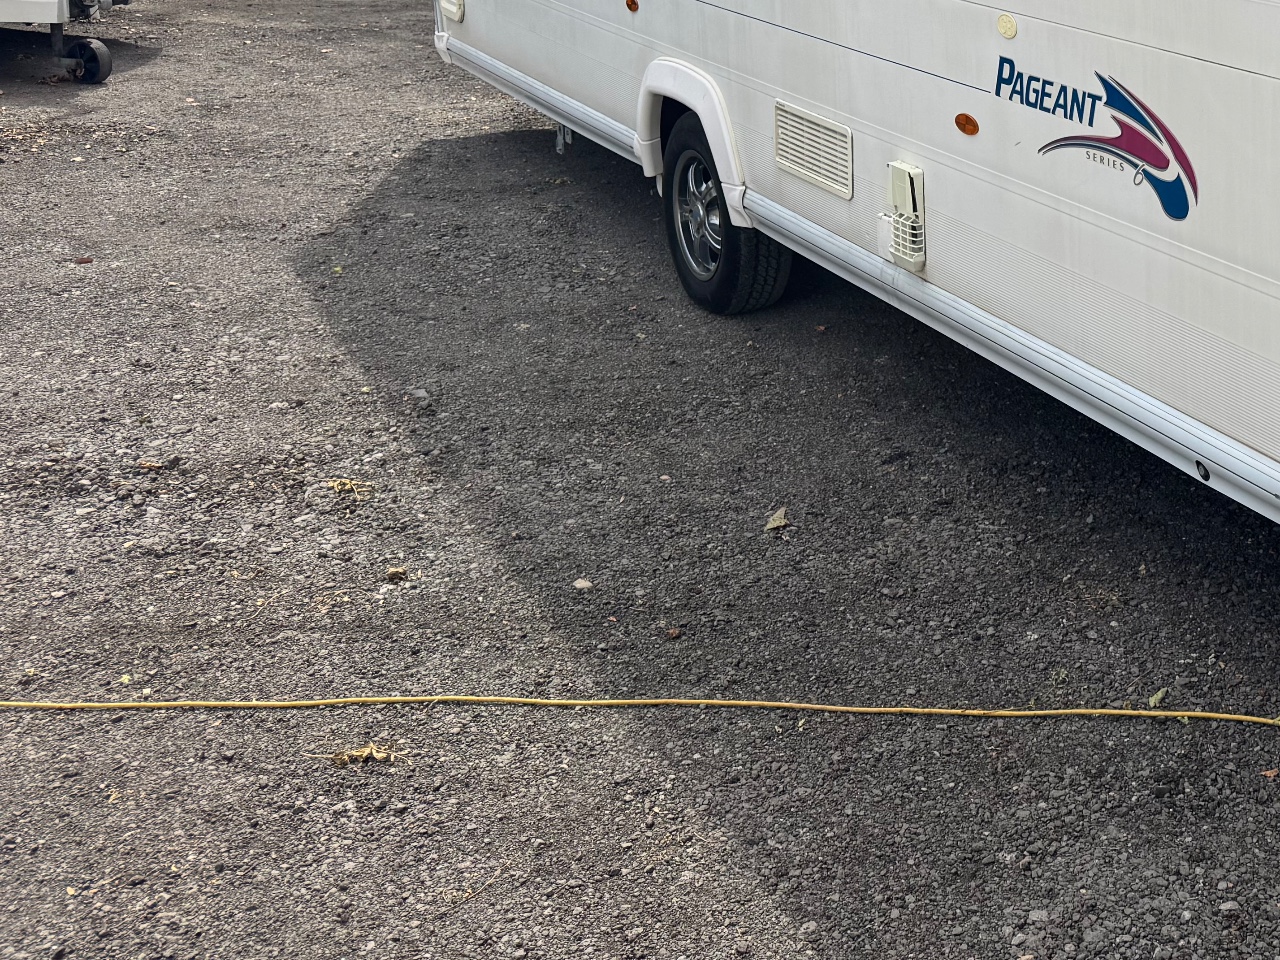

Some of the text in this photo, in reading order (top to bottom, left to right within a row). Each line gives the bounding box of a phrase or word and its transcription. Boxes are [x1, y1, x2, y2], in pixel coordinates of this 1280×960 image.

[994, 55, 1103, 128] PAGEANT
[1085, 150, 1146, 186] SERIES 6
